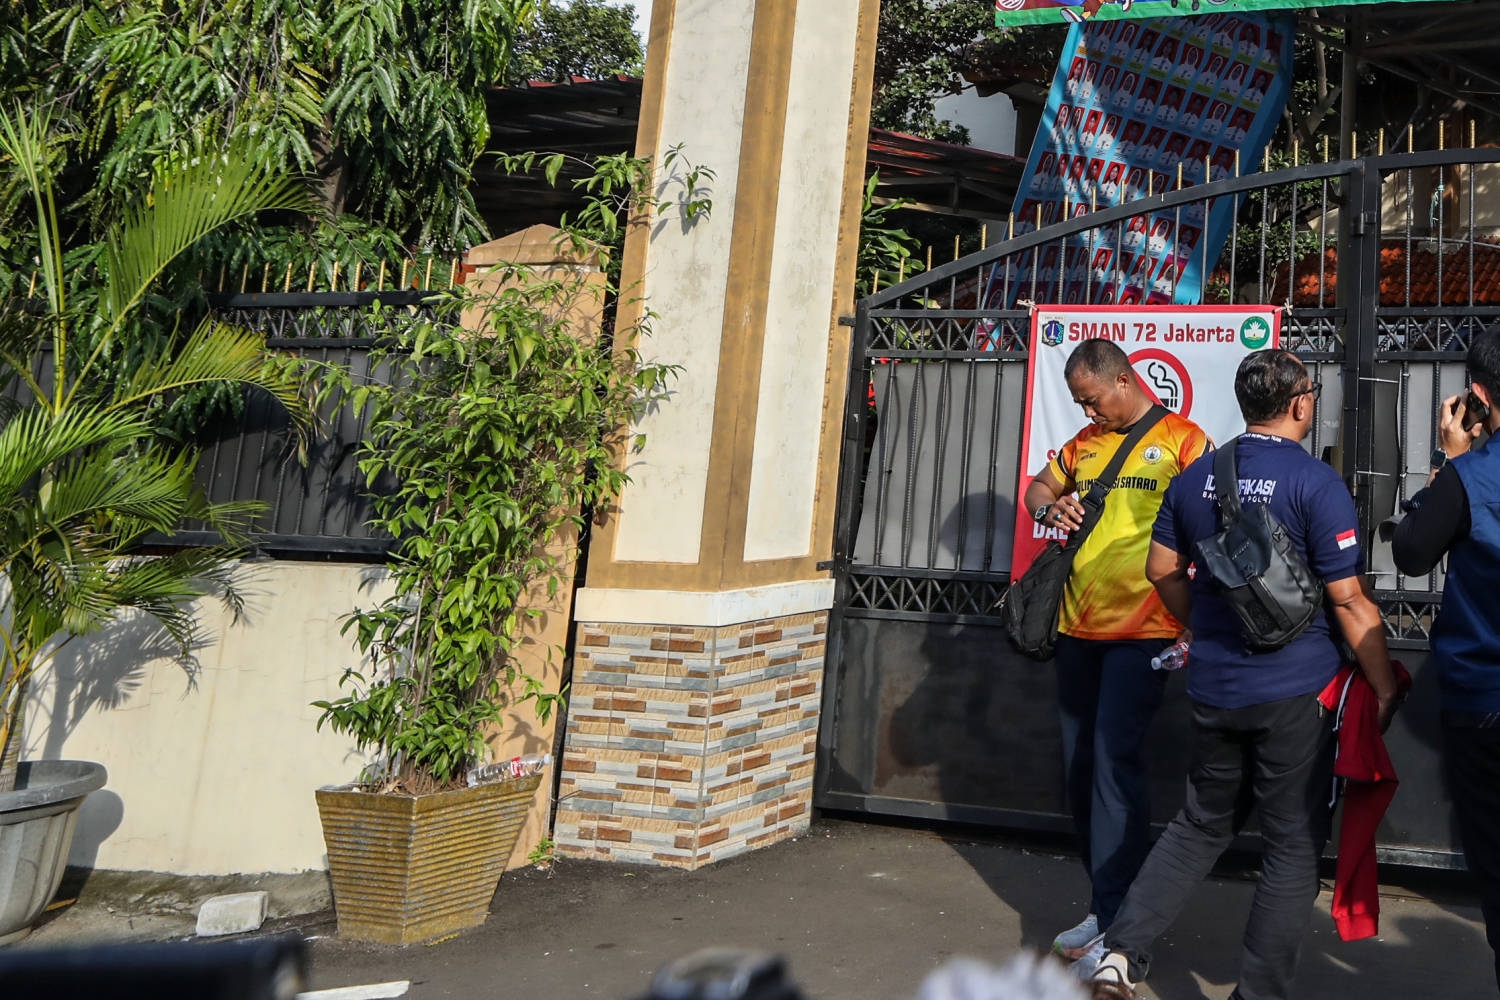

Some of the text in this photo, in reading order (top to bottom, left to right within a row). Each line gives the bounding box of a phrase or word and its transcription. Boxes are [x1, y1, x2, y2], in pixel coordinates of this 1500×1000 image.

[1067, 322, 1236, 343] SMAN 72 Jakarta
[1204, 474, 1277, 497] IDFIKASI
